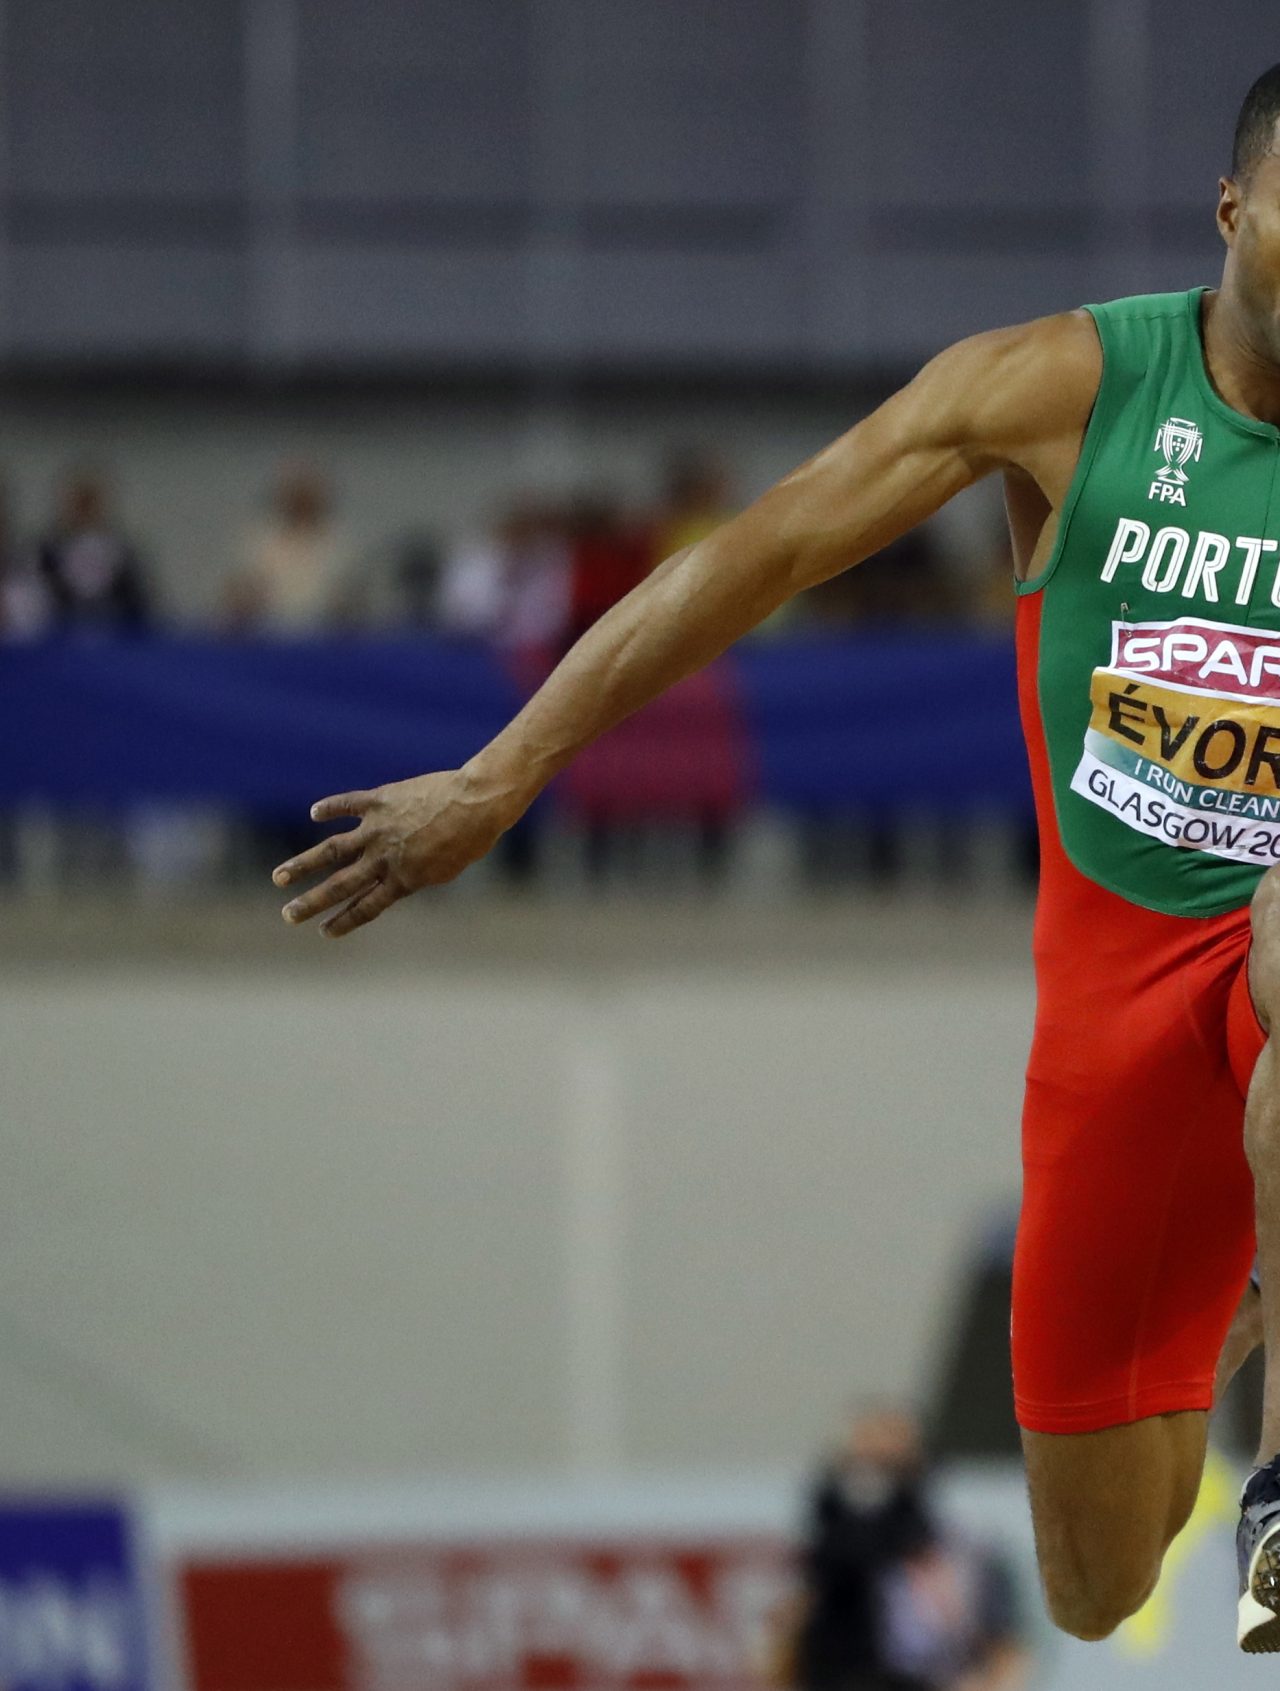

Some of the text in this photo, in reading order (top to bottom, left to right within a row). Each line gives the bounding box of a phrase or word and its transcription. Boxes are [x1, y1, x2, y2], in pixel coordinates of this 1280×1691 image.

[1148, 481, 1187, 507] FPA
[1134, 758, 1143, 776] I
[1146, 764, 1193, 803] RUN
[1088, 769, 1246, 850] GLASGOW
